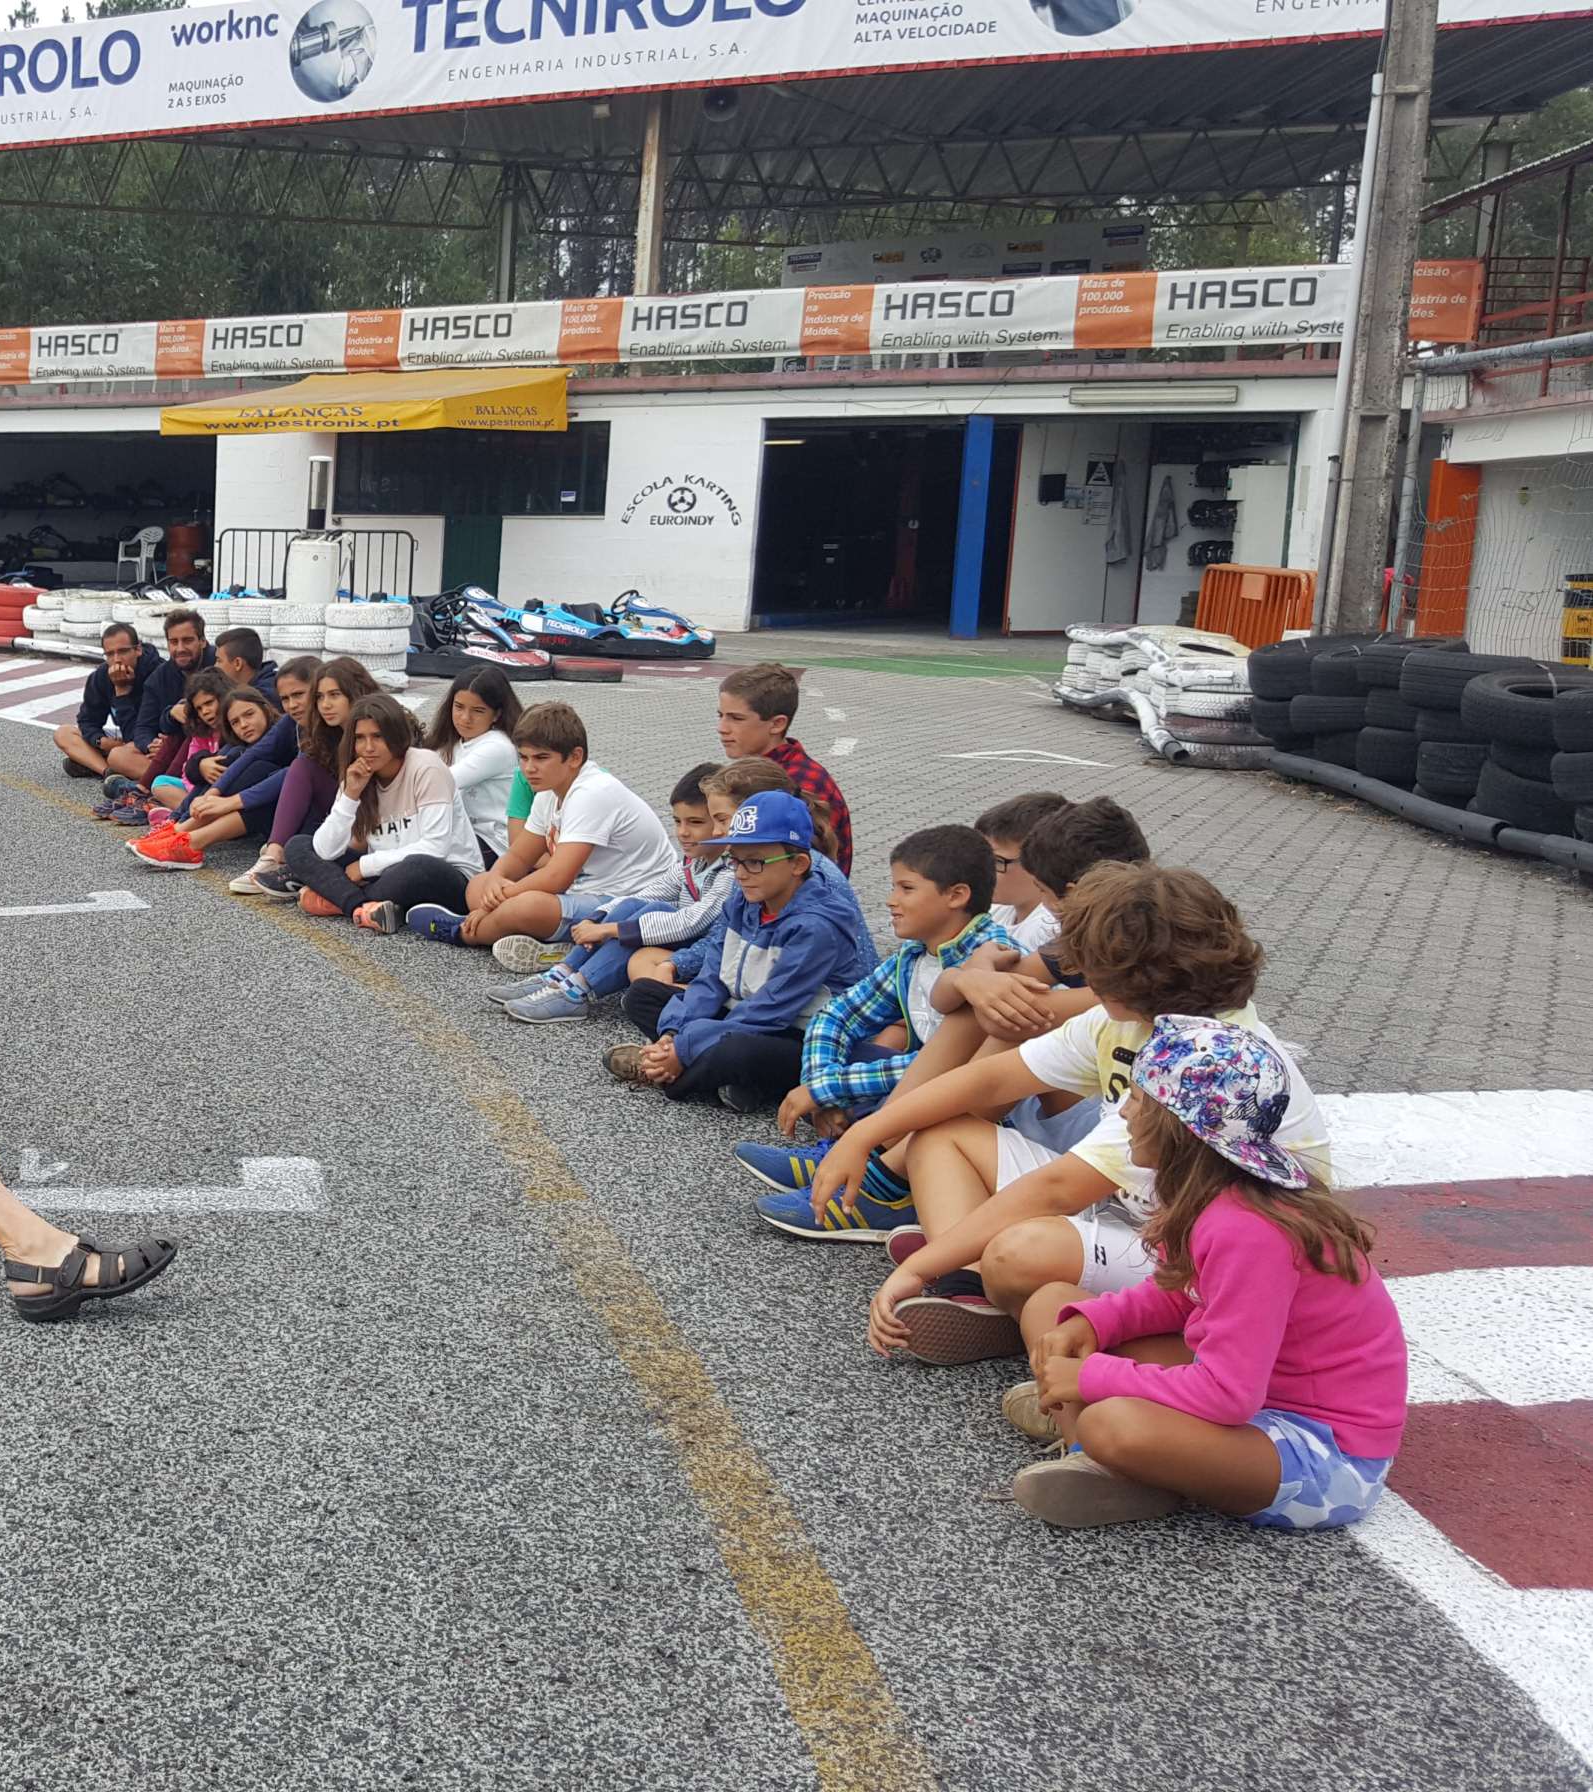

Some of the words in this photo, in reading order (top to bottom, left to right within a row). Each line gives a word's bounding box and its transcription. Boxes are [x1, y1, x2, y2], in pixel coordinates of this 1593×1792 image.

[856, 3, 963, 24] MAQUINAÇÃO
[171, 9, 279, 47] worknc
[854, 28, 892, 43] ALTA
[897, 20, 997, 39] VELOCIDADE
[448, 58, 564, 82] ENGENHARIA
[574, 46, 698, 69] INDUSTRIAL,
[709, 42, 747, 57] S.A.
[168, 74, 244, 93] MAQUINAÇÃO
[70, 105, 98, 119] S.A.
[167, 98, 174, 109] 2
[175, 97, 184, 108] A
[185, 96, 193, 107] 5
[195, 94, 226, 106] EIXOS
[1082, 279, 1108, 288] Mais
[1110, 278, 1125, 288] de
[1168, 277, 1318, 310] HASCO
[883, 290, 1015, 320] HASCO
[1451, 293, 1467, 304] de
[631, 301, 749, 331] HASCO
[212, 324, 303, 350] HASCO
[408, 313, 513, 341] HASCO
[1165, 323, 1245, 340] Enabling
[1252, 321, 1287, 336] with
[38, 333, 119, 357] HASCO
[881, 333, 951, 348] Enabling
[957, 330, 990, 345] with
[995, 328, 1063, 345] System.
[476, 406, 538, 417] BALANÇAS
[204, 418, 400, 430] www.pestronix.pt
[621, 476, 674, 525] ESCOLA
[684, 474, 743, 526] KARTING
[649, 515, 716, 526] EUROINDY
